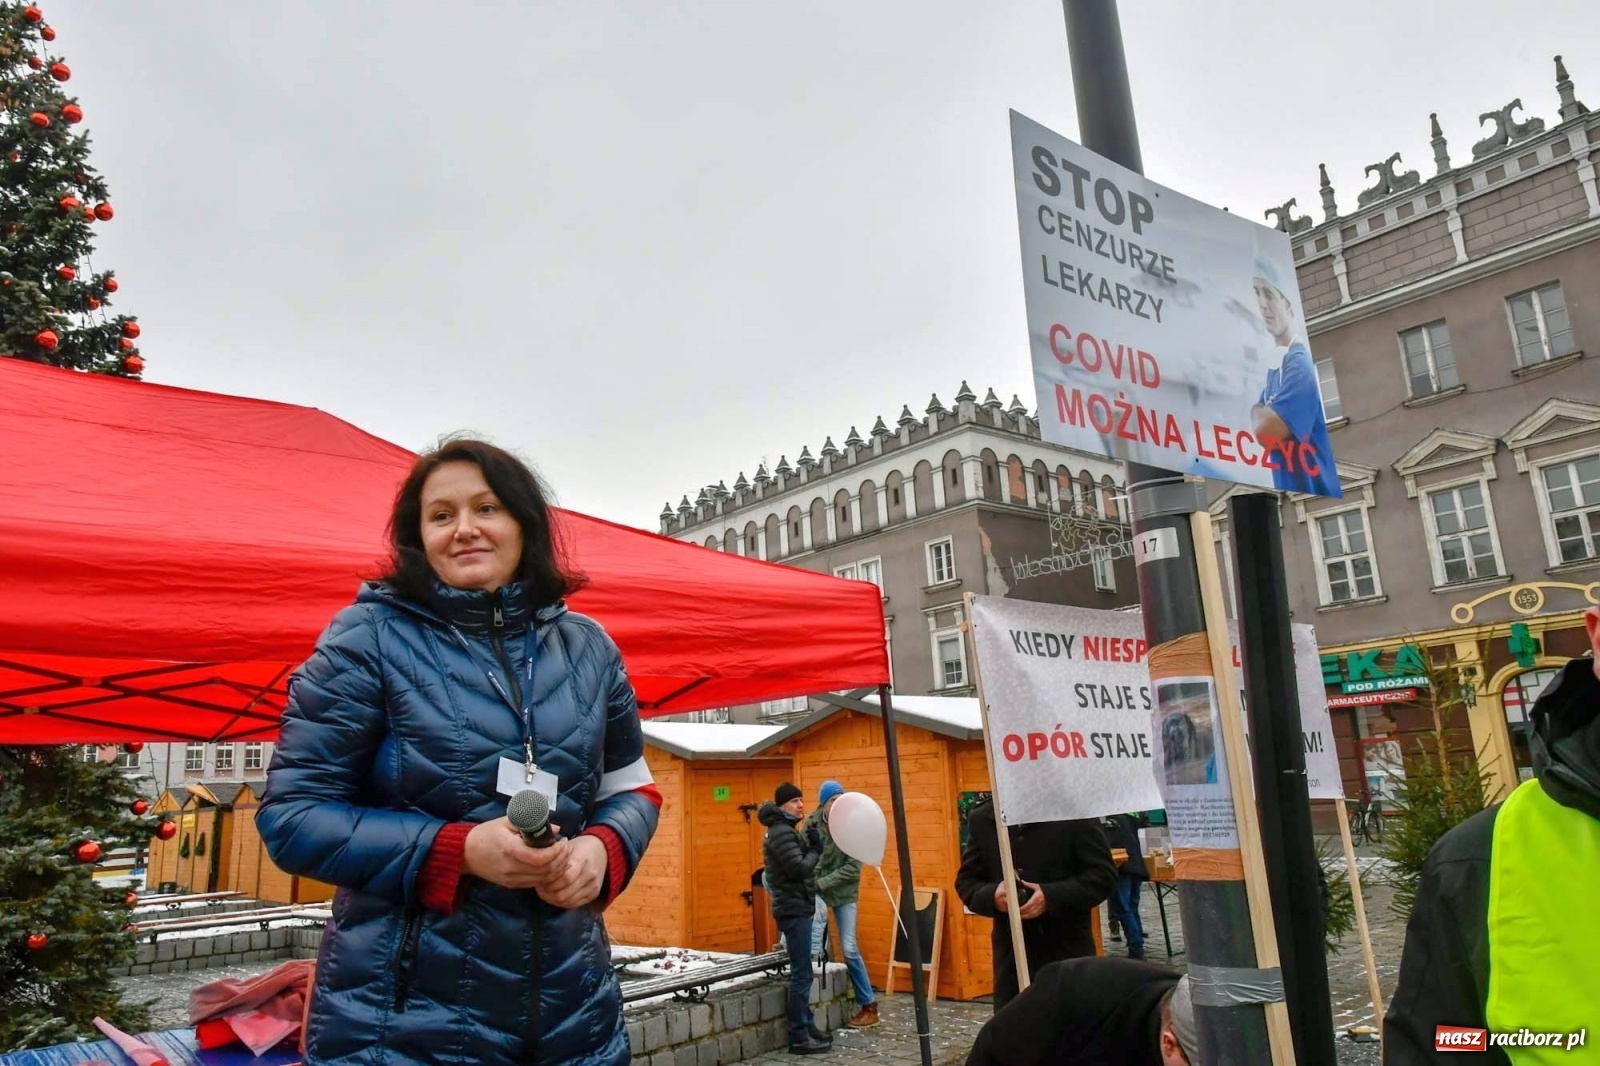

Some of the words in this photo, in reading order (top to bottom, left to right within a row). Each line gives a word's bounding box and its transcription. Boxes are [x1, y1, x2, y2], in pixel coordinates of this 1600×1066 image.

[1031, 145, 1154, 235] STOP
[1037, 205, 1177, 284] CENZURZE
[1041, 255, 1164, 323] LEKARZY
[1049, 323, 1161, 389] COVID
[1055, 384, 1187, 453] MOŻNA
[1193, 420, 1321, 477] LECZYĆ
[1142, 537, 1157, 554] 17
[1517, 594, 1537, 604] 1953
[1009, 629, 1075, 660] KIEDY
[1074, 683, 1136, 710] STAJE
[1347, 683, 1373, 692] POD
[1002, 723, 1089, 762] OPÓR
[1091, 732, 1151, 758] STAJE
